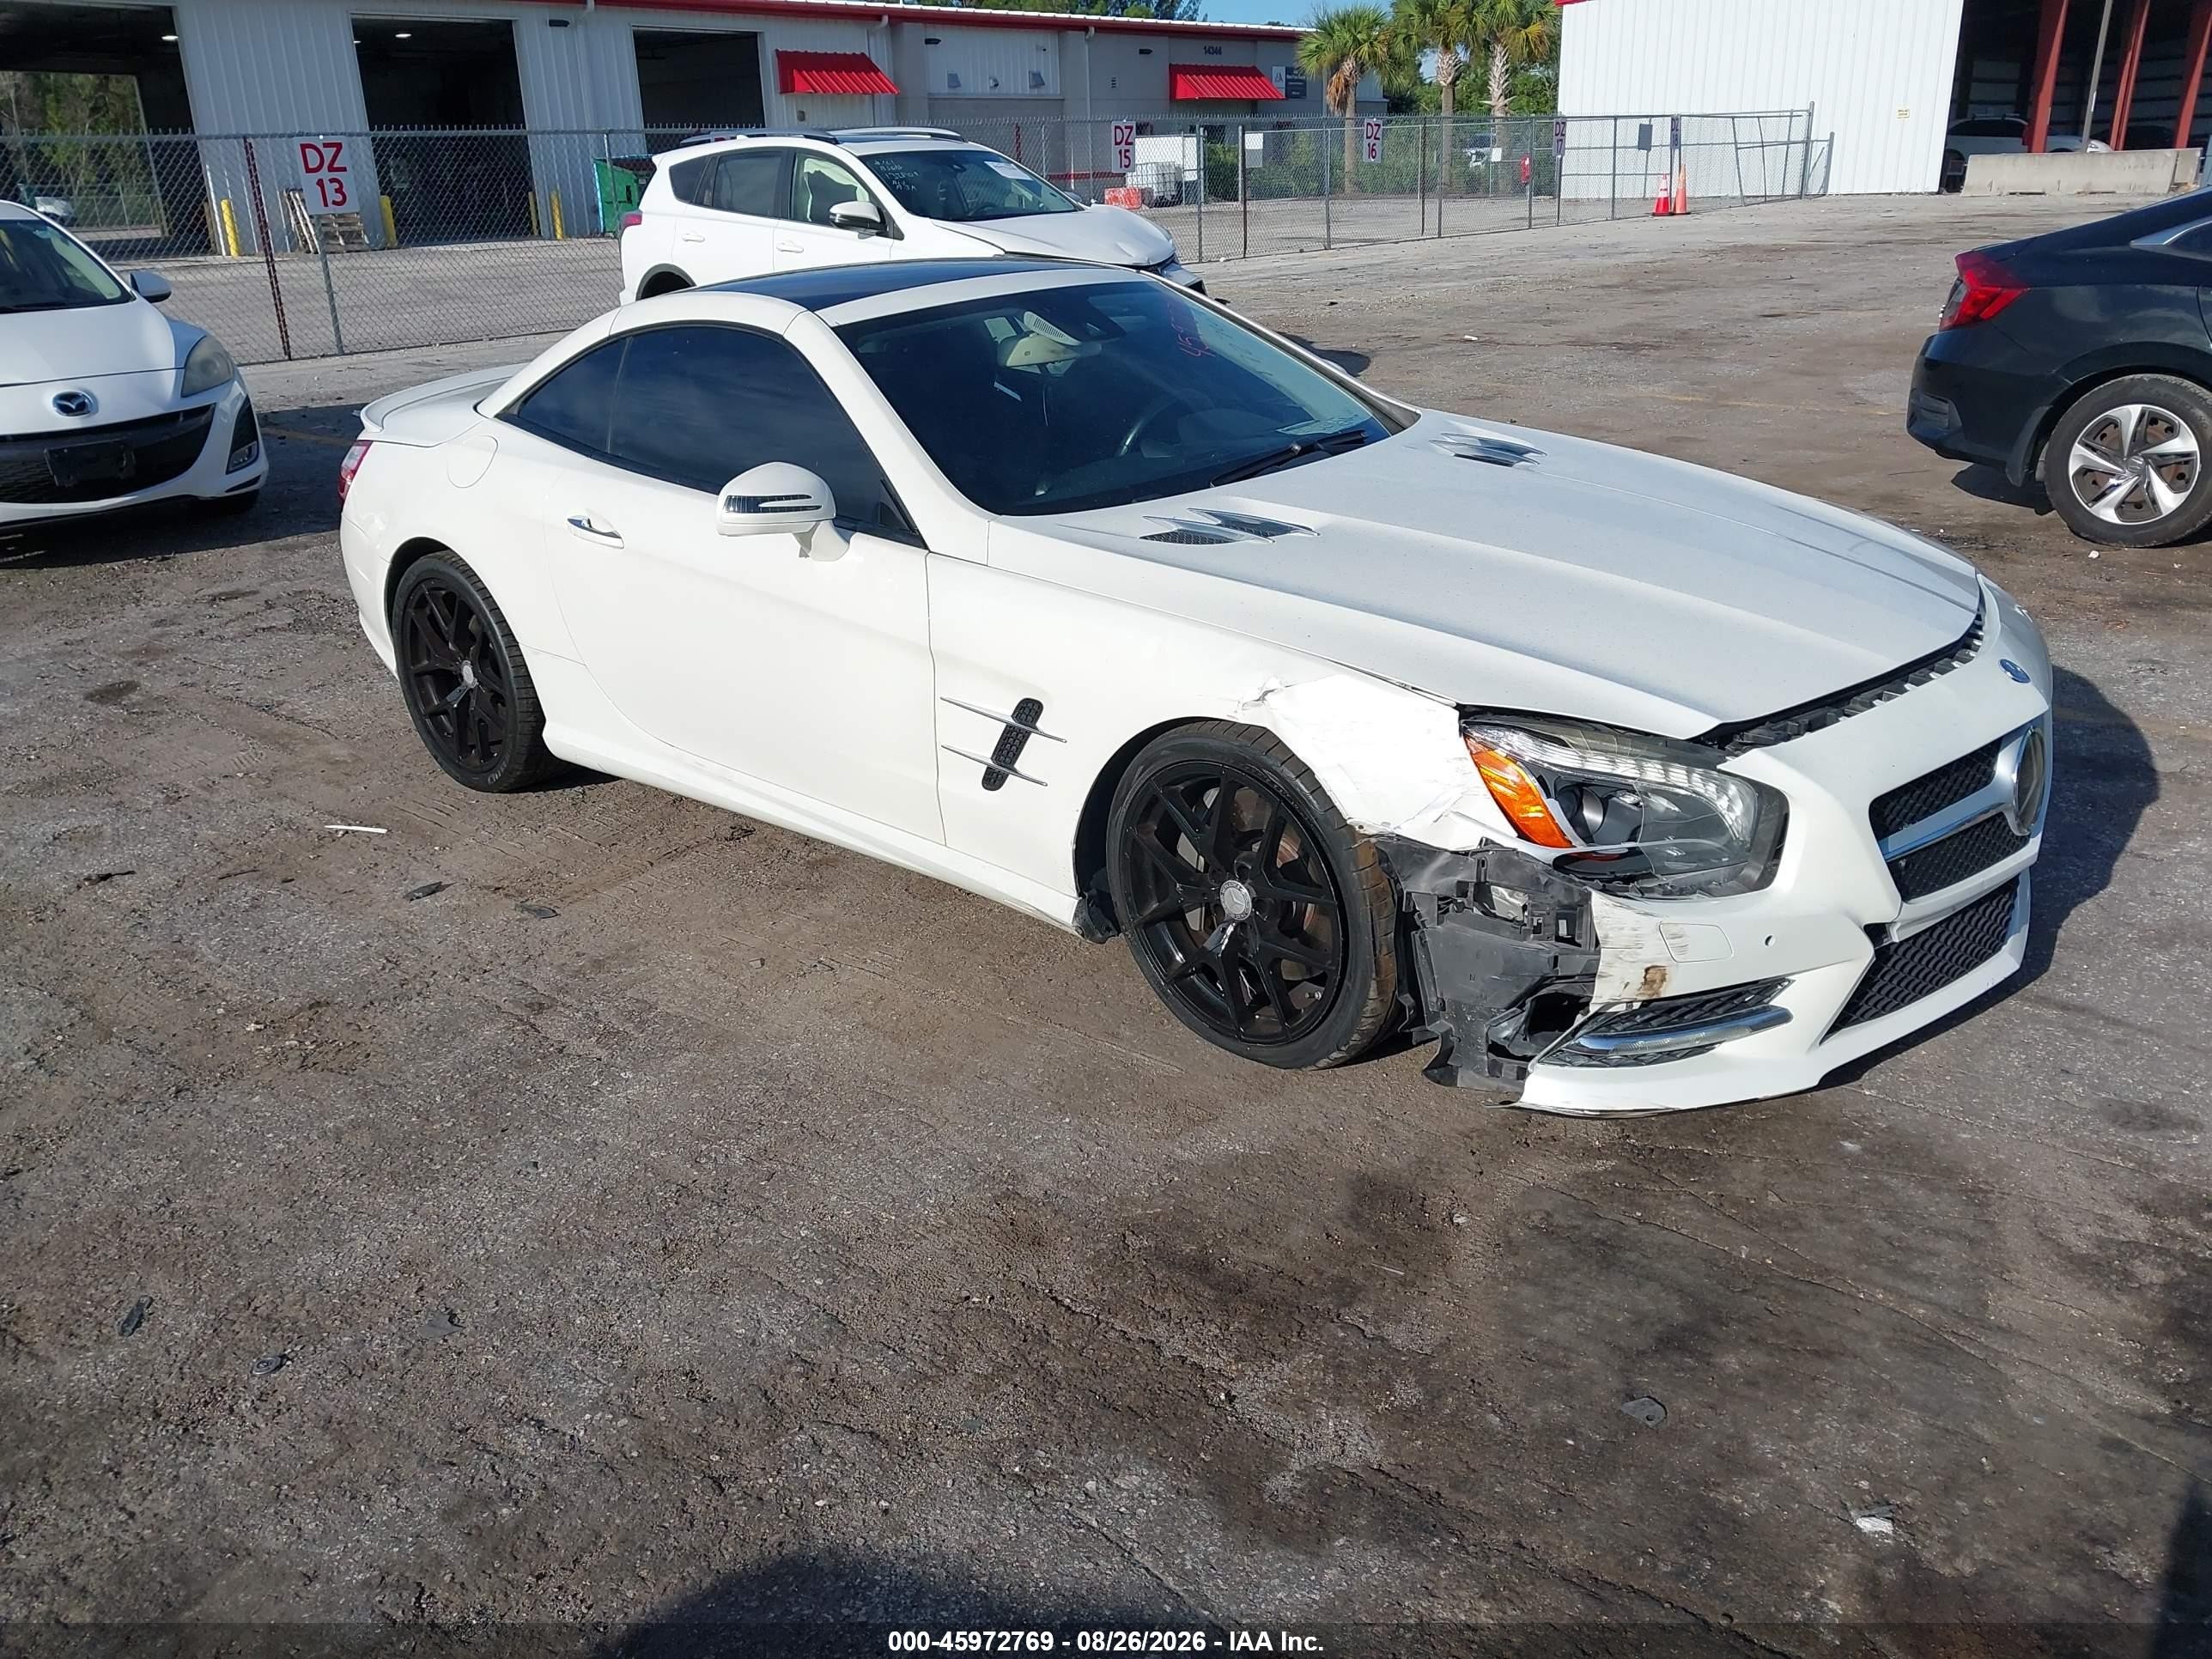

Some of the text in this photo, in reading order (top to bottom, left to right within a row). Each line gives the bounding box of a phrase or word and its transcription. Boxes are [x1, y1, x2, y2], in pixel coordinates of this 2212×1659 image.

[1115, 125, 1133, 145] DZ
[1366, 123, 1381, 140] DZ
[1555, 122, 1566, 137] DZ
[1368, 143, 1376, 159] 16
[1557, 139, 1563, 153] 17
[300, 143, 347, 173] DZ
[1119, 149, 1131, 168] 15
[316, 178, 347, 207] 13
